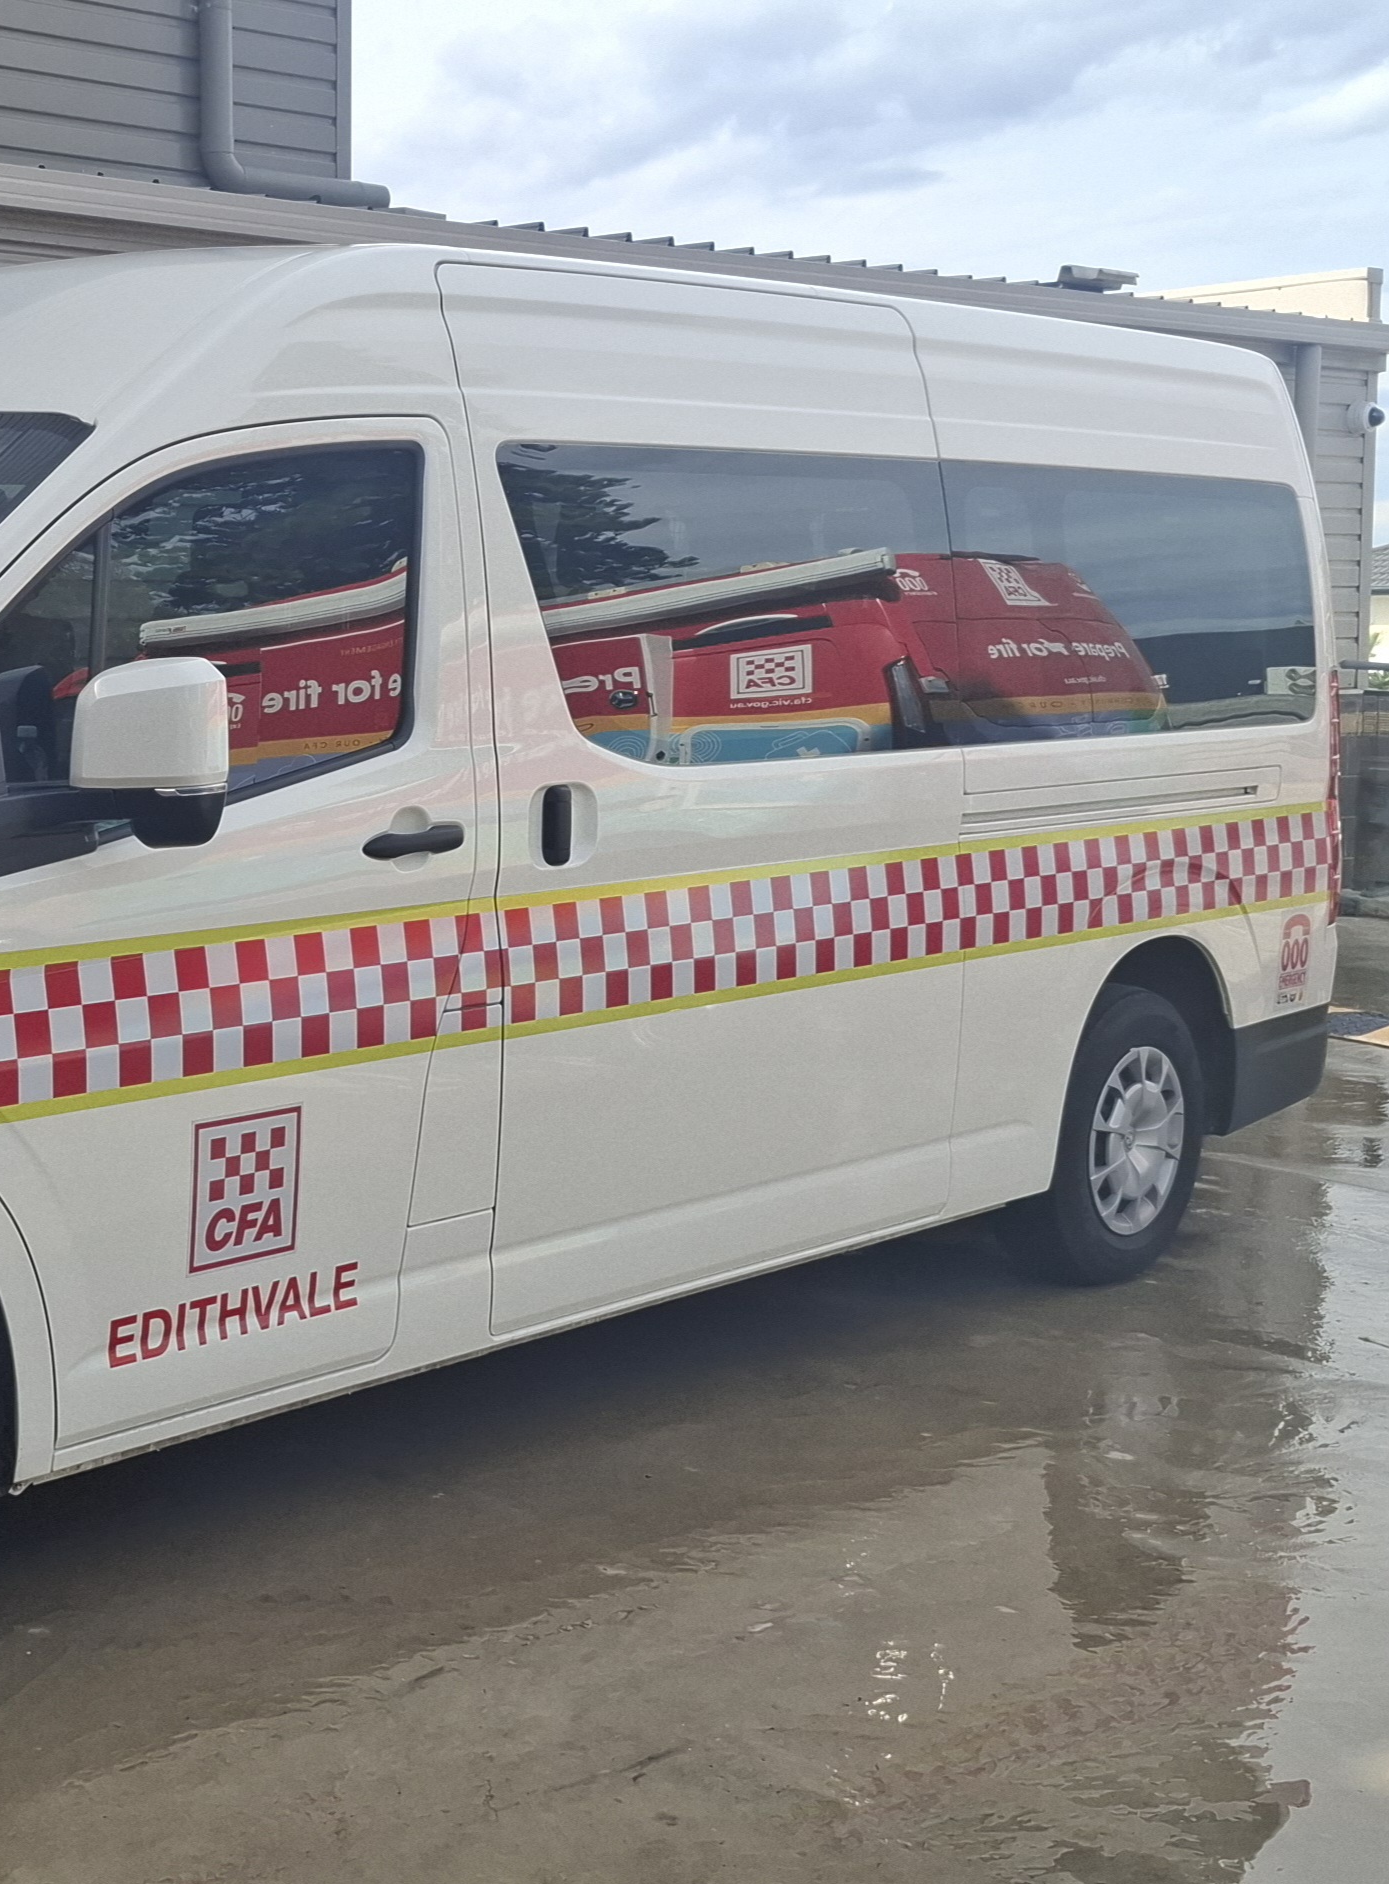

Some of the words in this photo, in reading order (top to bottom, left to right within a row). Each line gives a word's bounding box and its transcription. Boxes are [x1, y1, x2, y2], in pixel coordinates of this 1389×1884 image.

[1281, 937, 1309, 972] 000
[205, 1197, 283, 1252] CFA
[108, 1261, 360, 1369] EDITHVALE
